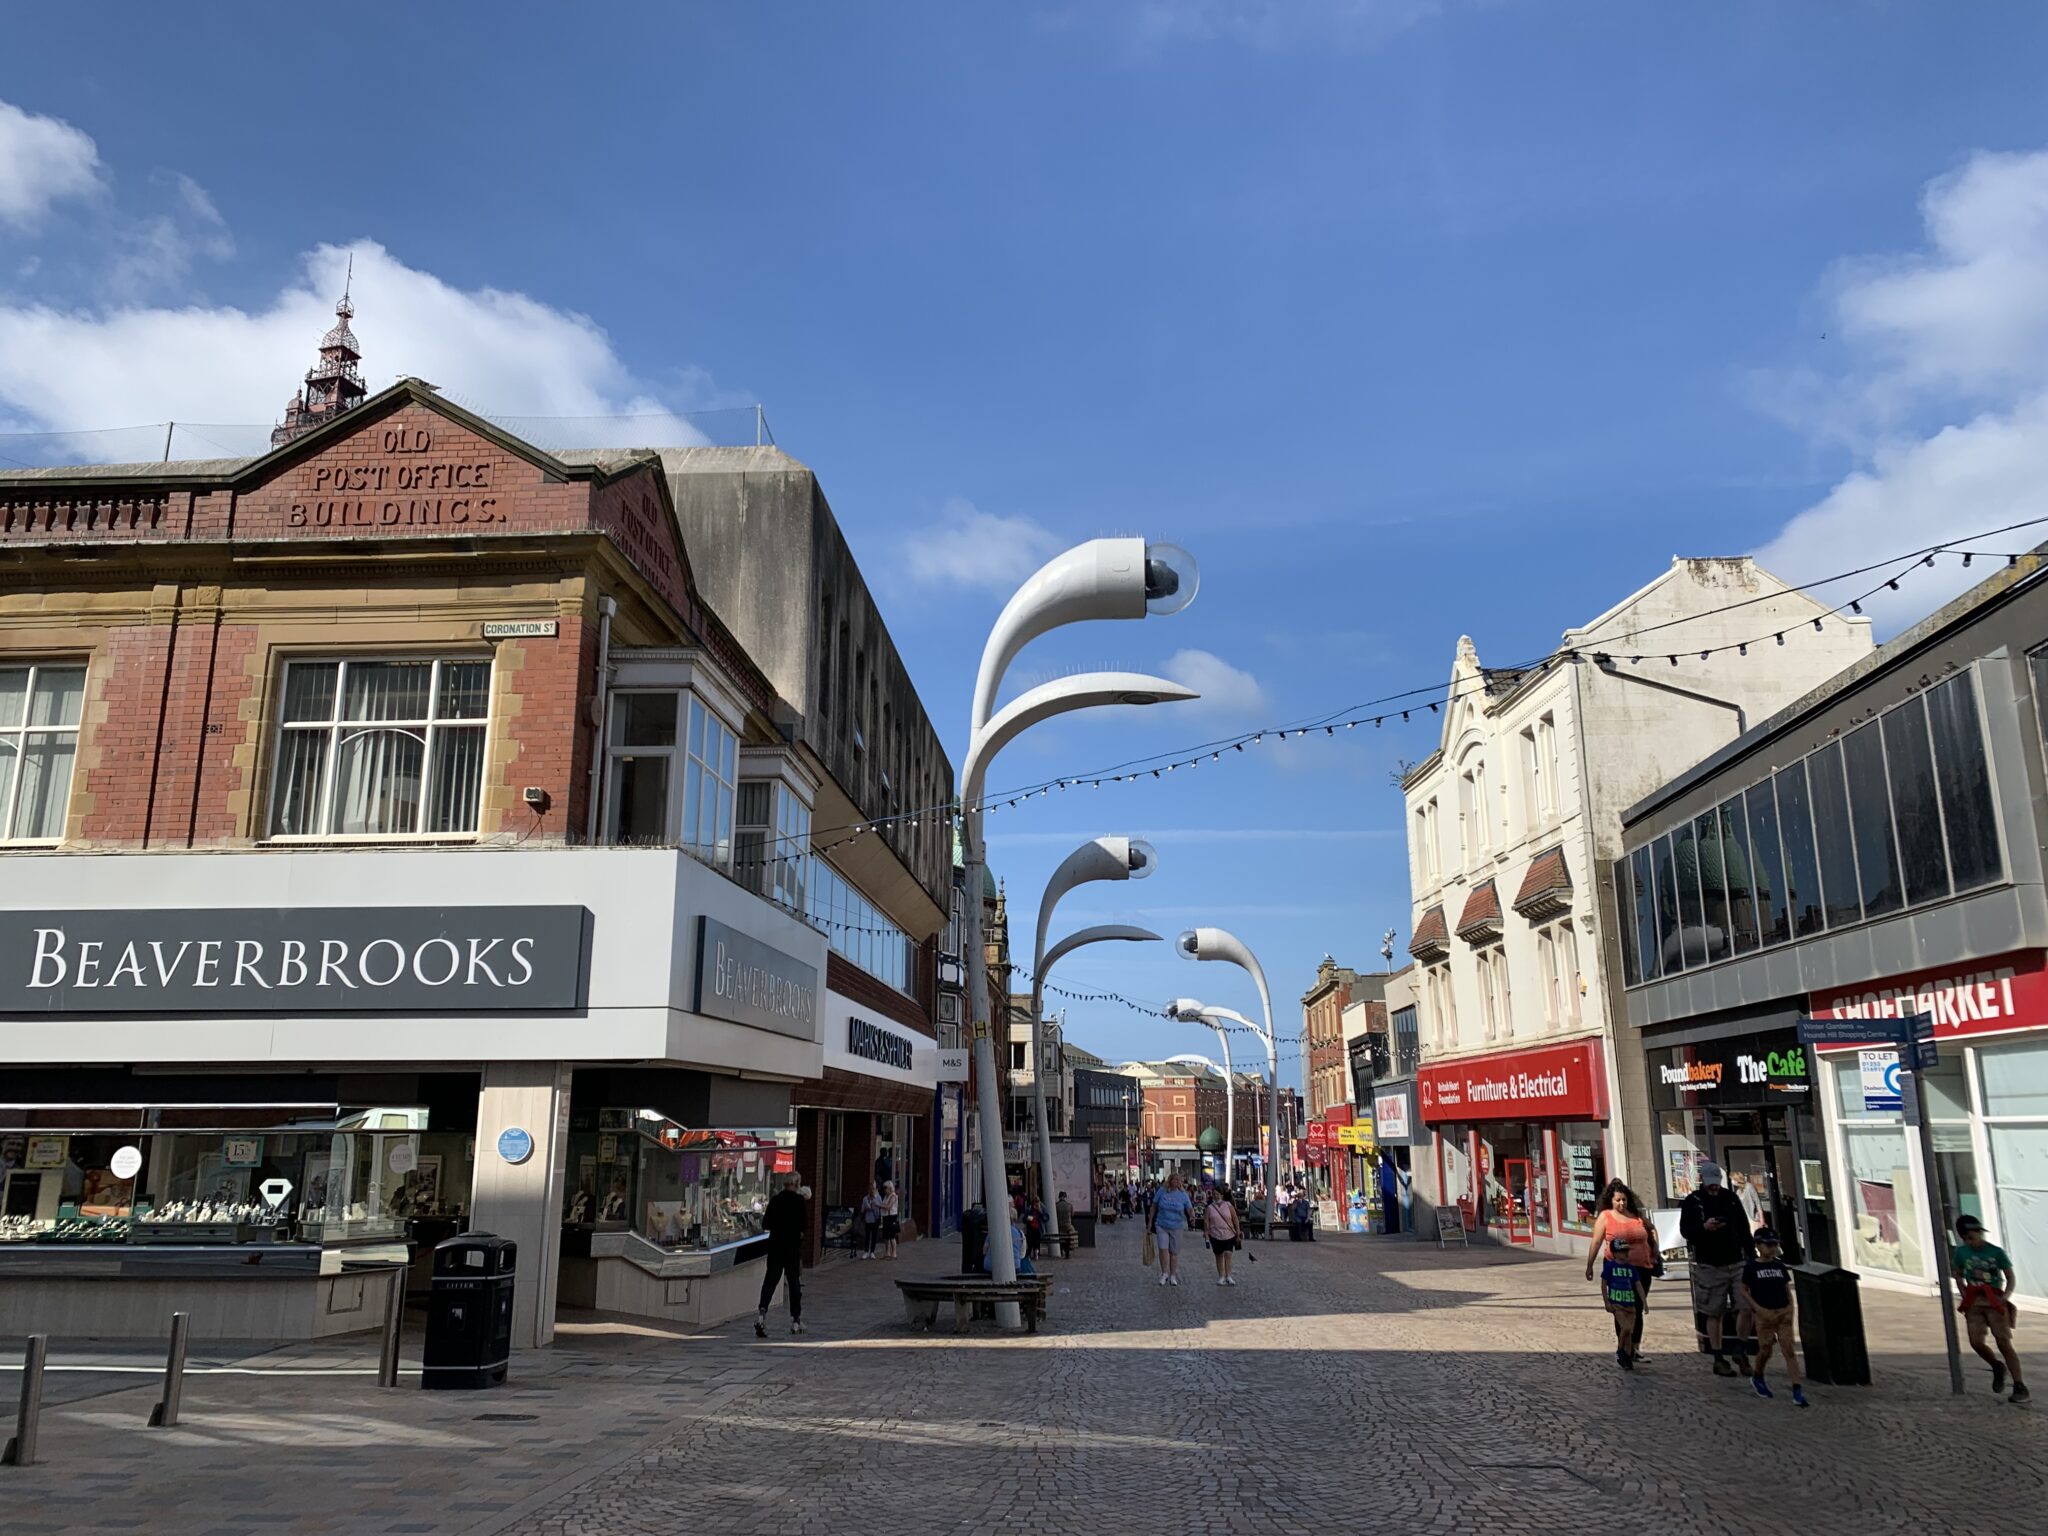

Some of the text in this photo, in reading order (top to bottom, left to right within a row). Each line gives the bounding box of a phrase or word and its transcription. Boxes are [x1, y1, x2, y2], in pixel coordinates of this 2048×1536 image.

[384, 430, 431, 453] OLD
[314, 462, 491, 491] POST OFFICE
[485, 623, 542, 634] CORONATION
[974, 1021, 987, 1037] H
[1825, 1022, 1854, 1030] Gardens
[1838, 1031, 1867, 1039] Shopping
[942, 1058, 962, 1068] M&S
[1467, 1067, 1568, 1102] Furniture & Electrical
[1438, 1092, 1461, 1104] Foundation
[1610, 1289, 1636, 1303] NOISE
